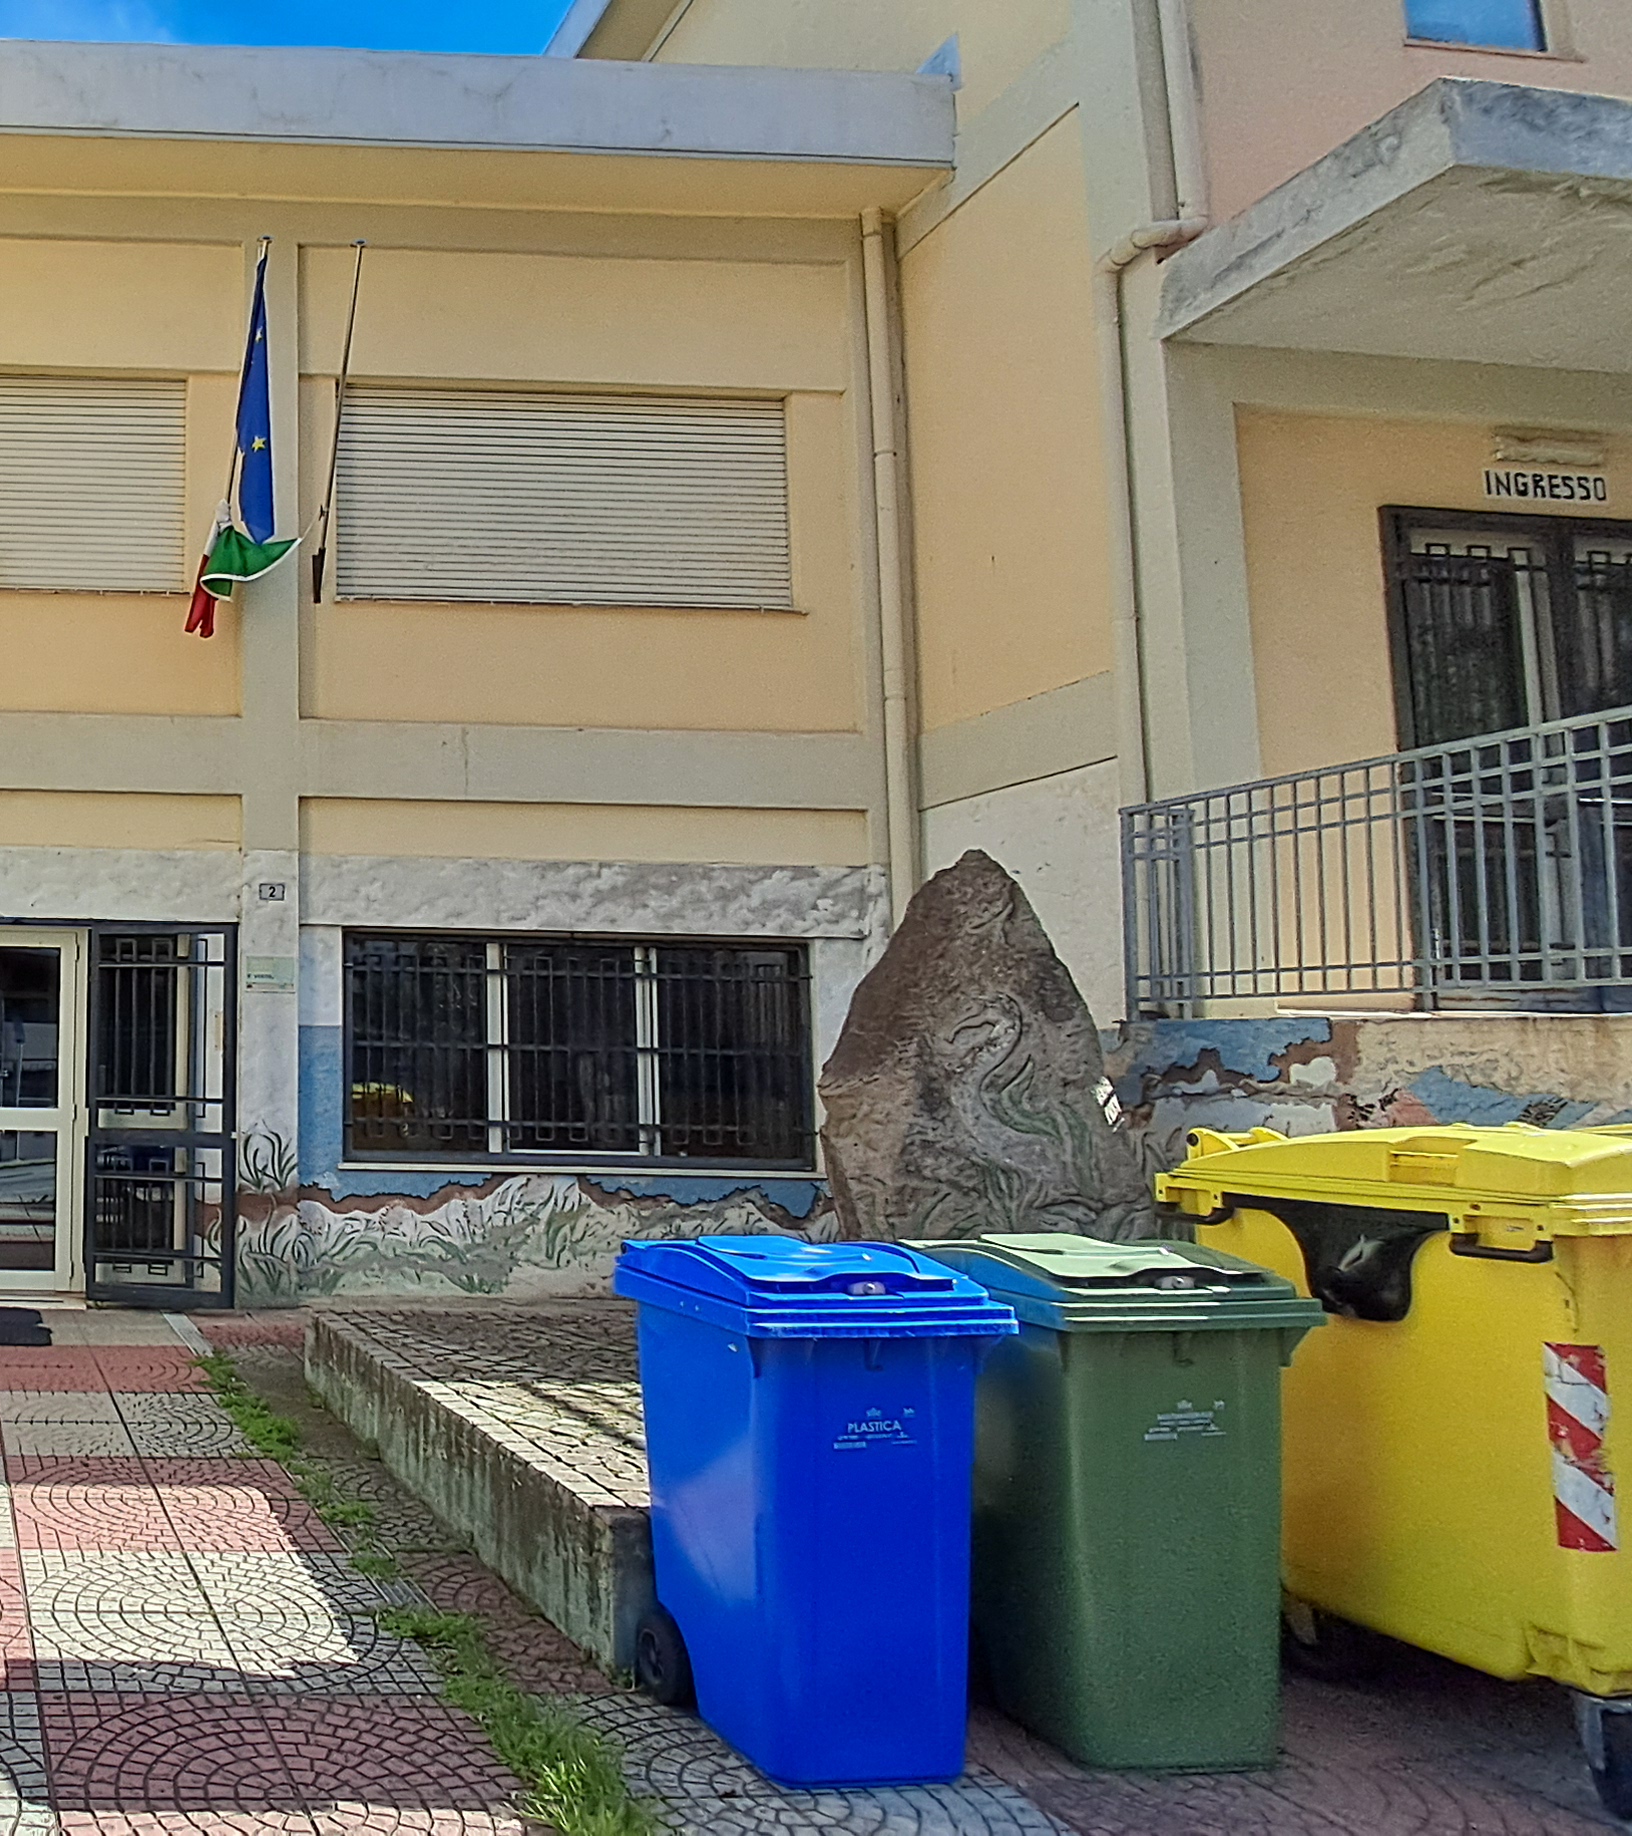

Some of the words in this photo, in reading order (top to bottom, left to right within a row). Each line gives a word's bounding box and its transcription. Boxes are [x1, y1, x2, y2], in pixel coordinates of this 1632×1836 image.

[1484, 470, 1607, 501] INGRESSO
[268, 886, 276, 898] 2
[848, 1420, 902, 1433] PLASTICA
